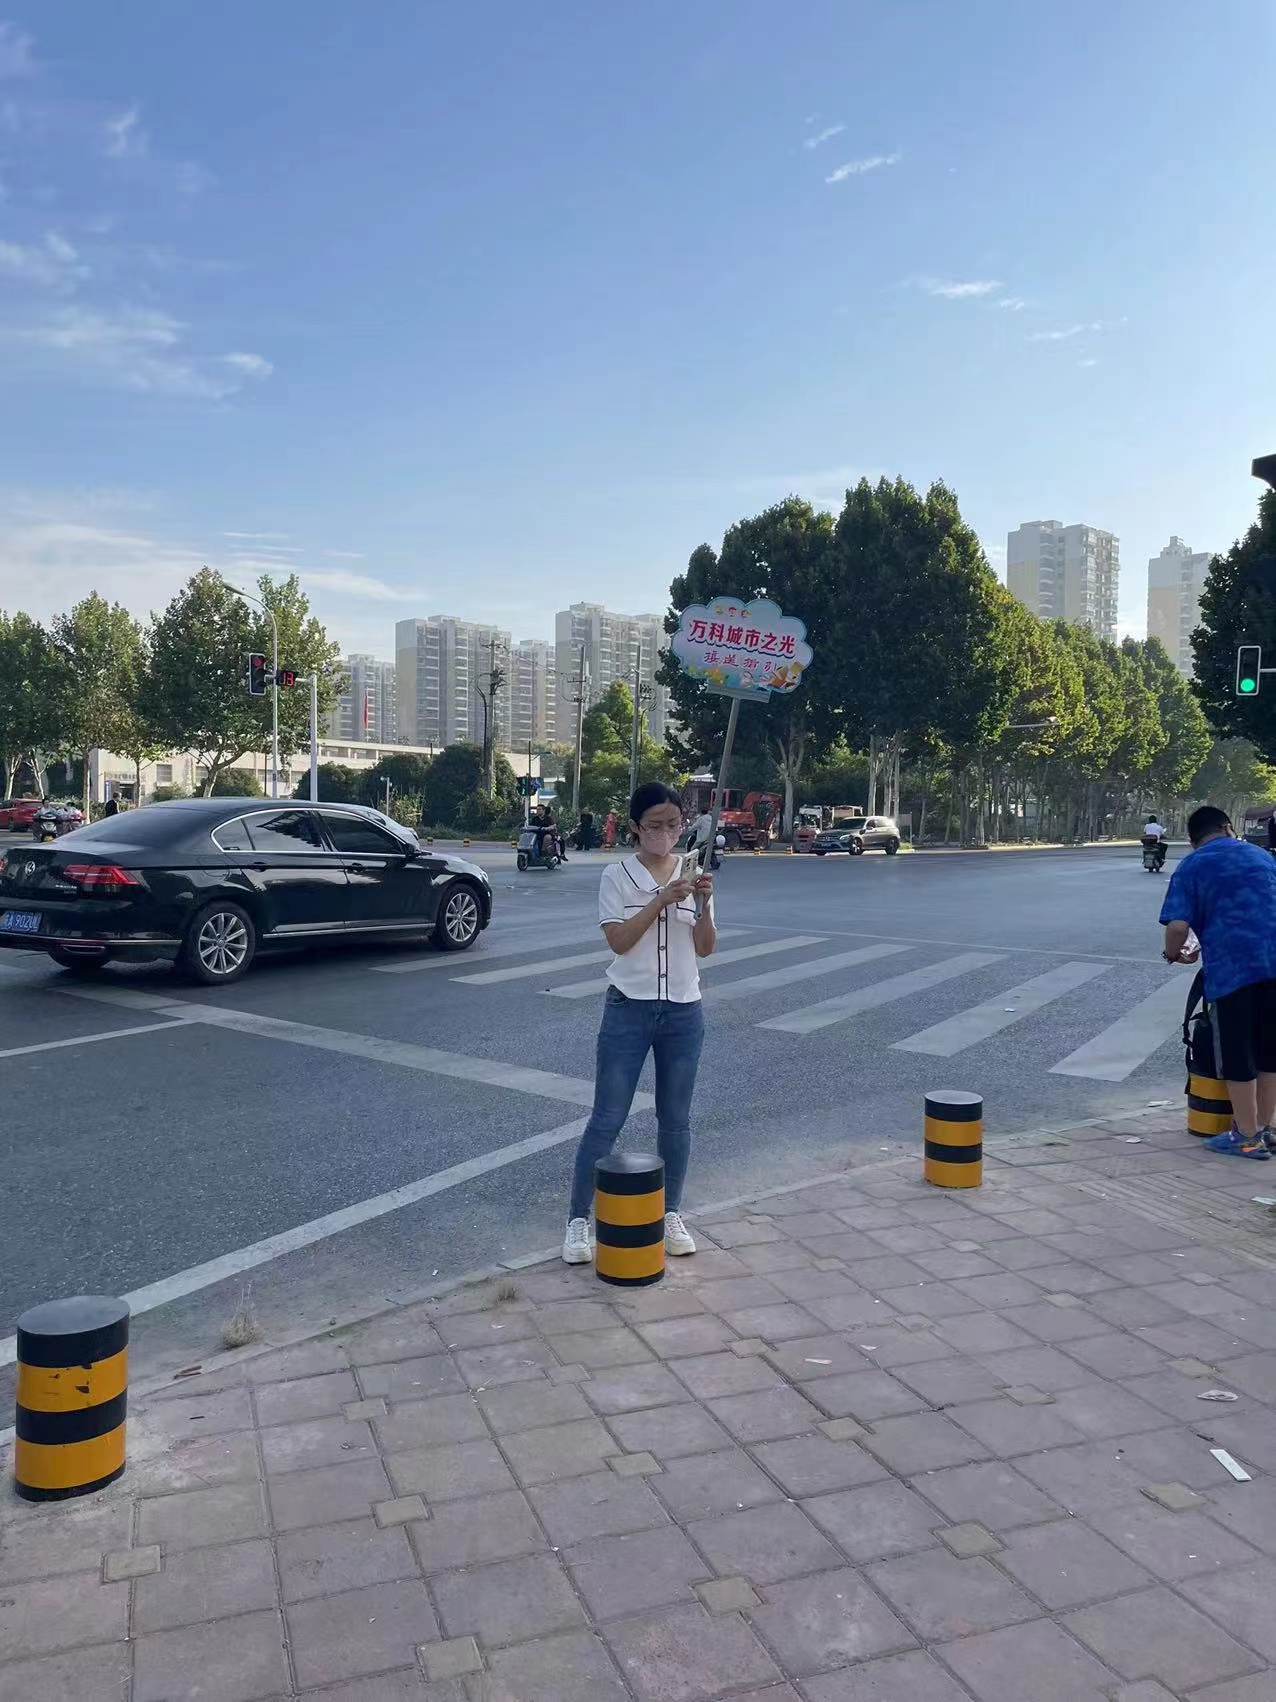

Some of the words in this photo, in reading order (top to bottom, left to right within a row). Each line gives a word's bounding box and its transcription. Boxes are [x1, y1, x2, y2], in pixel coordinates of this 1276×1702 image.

[690, 619, 796, 654] 万科城市之光
[283, 672, 294, 686] 13
